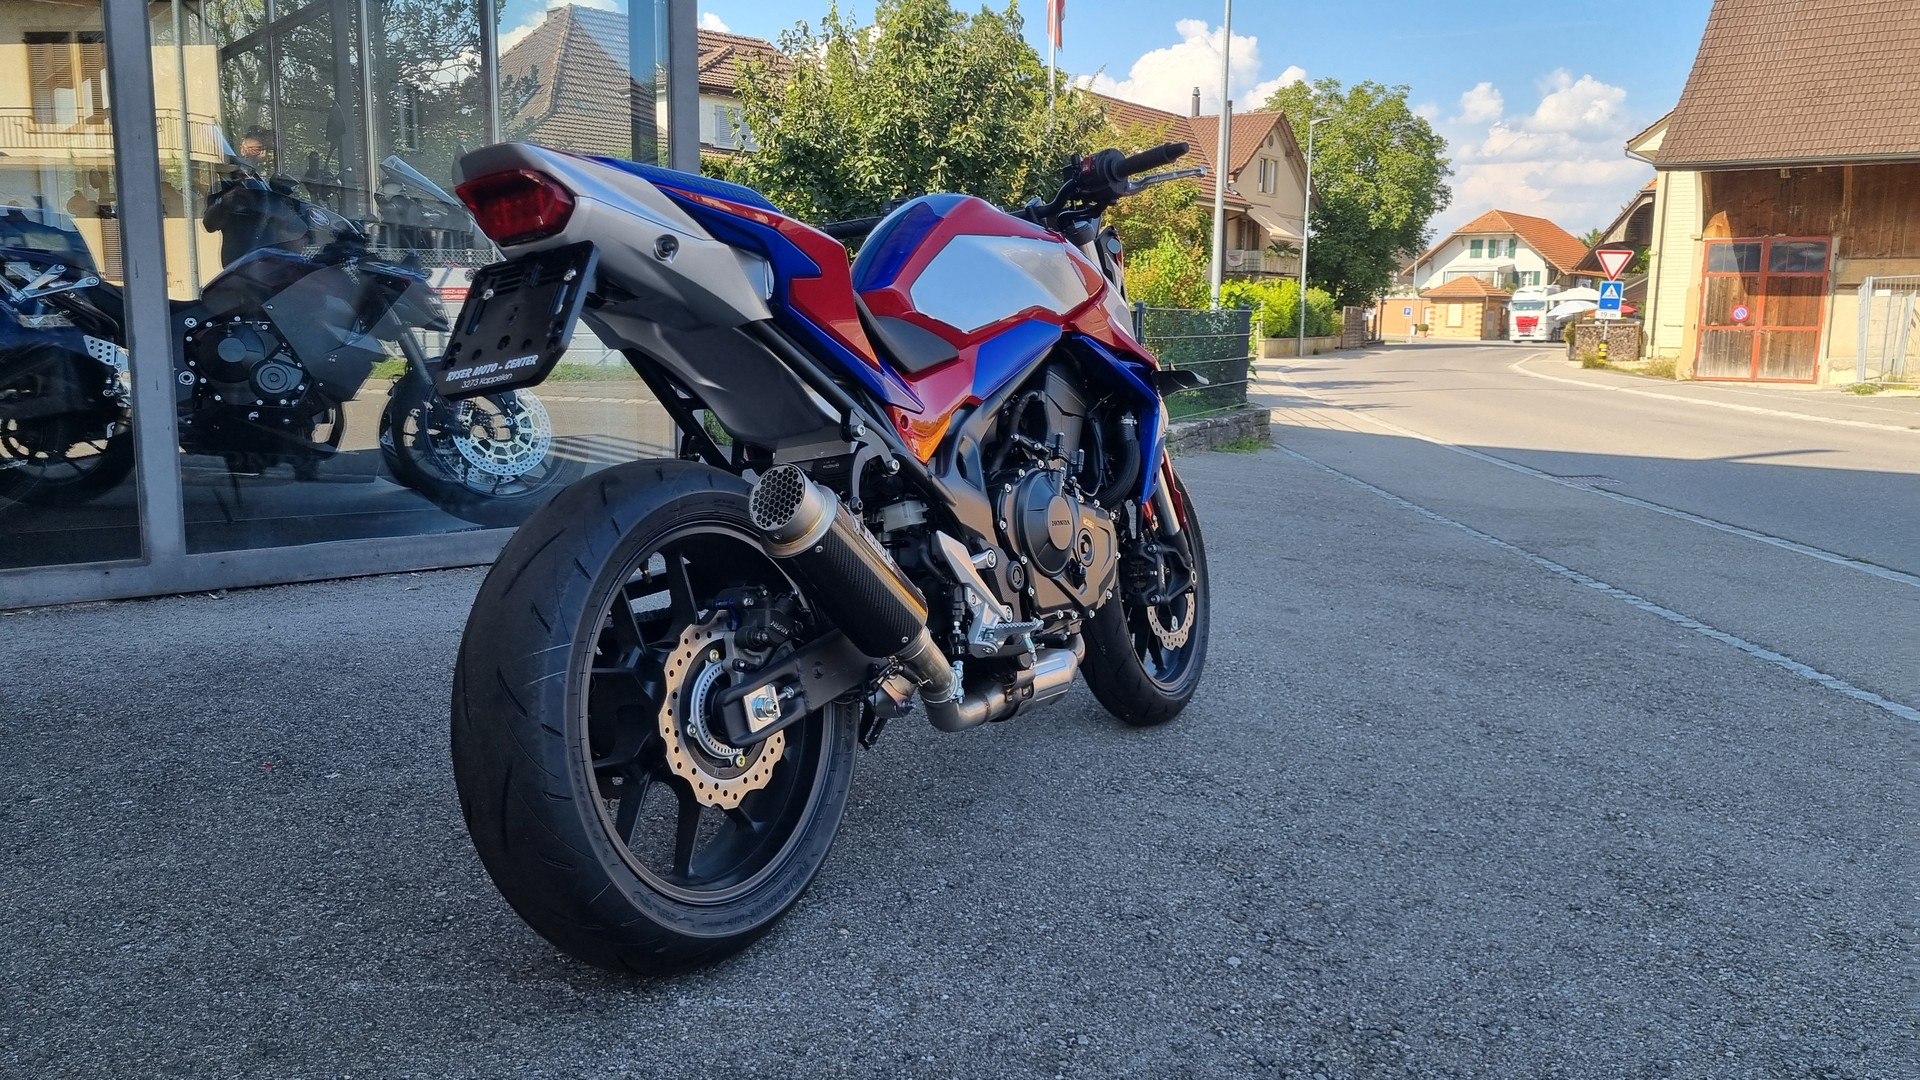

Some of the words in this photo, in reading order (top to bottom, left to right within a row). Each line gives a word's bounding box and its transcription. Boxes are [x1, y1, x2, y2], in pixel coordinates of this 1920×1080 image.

[446, 368, 473, 382] RYSER
[472, 362, 498, 376] MOTO
[504, 354, 539, 370] CENTER
[461, 378, 479, 389] 3273
